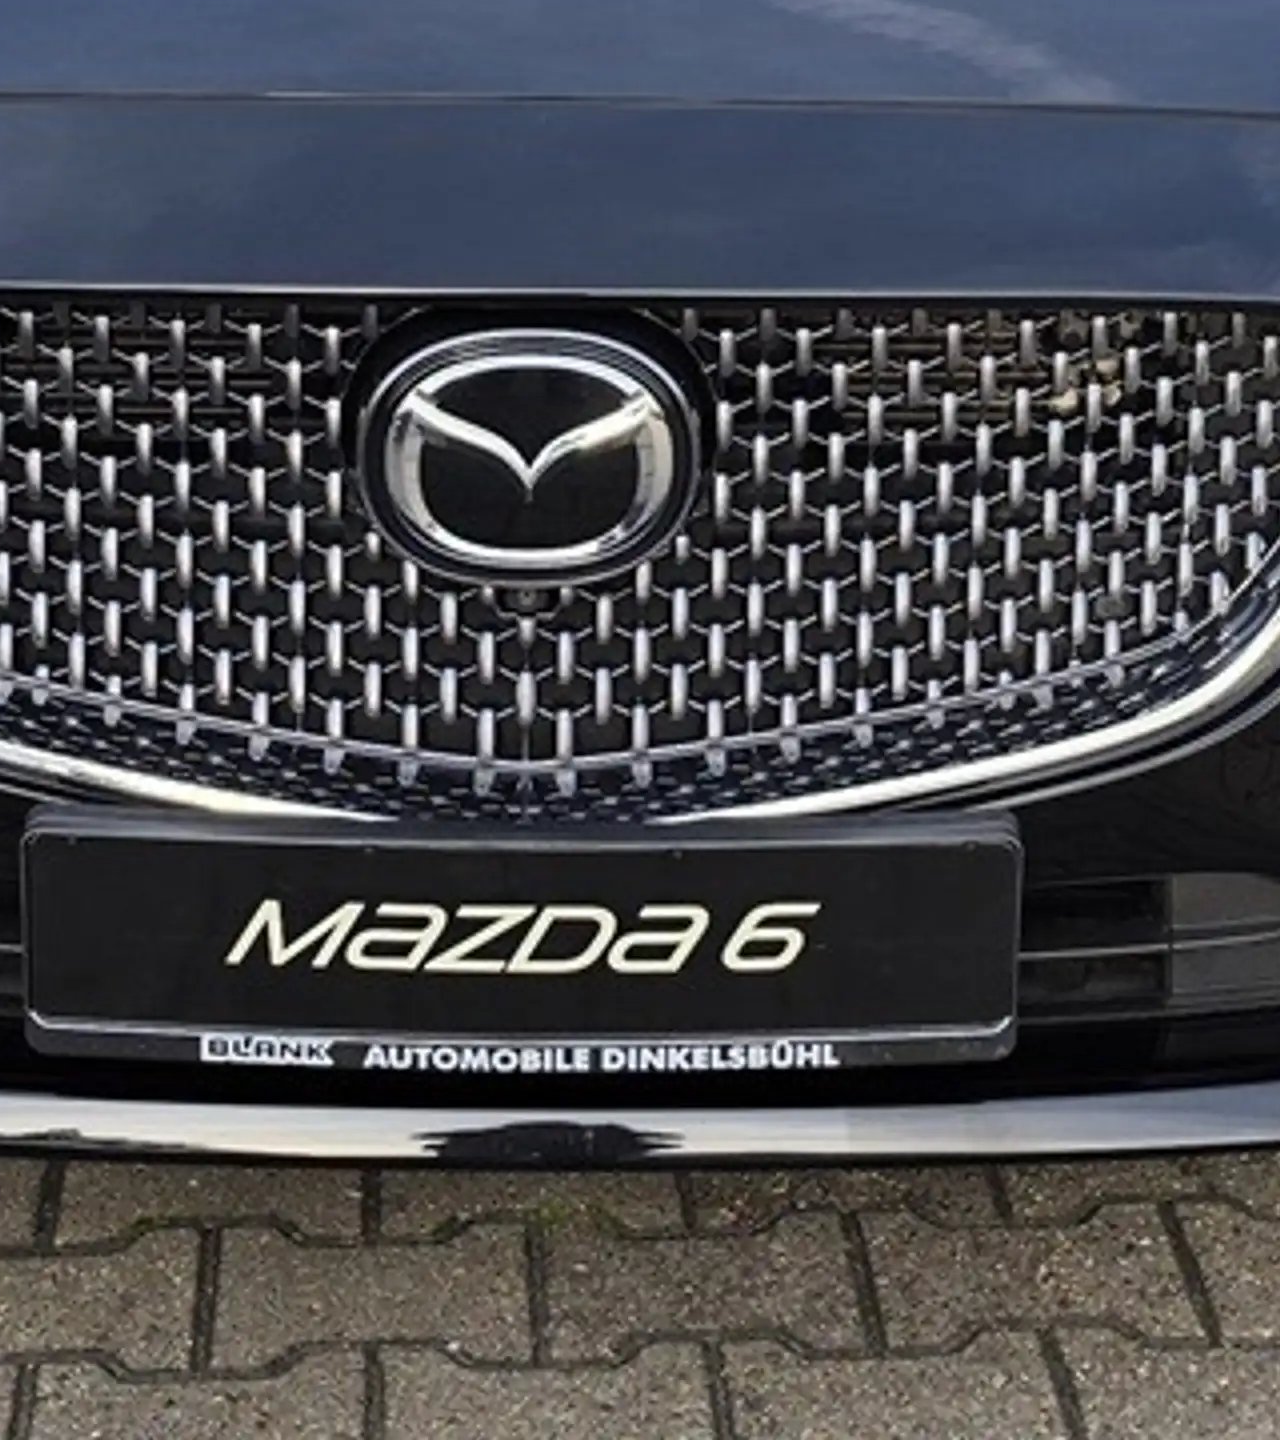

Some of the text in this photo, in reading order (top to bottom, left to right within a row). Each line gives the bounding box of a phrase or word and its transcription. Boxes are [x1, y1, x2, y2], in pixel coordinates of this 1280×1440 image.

[720, 901, 821, 972] 6
[206, 1035, 842, 1073] BLANK AUTOMOBILE DINKELSBÜHL
